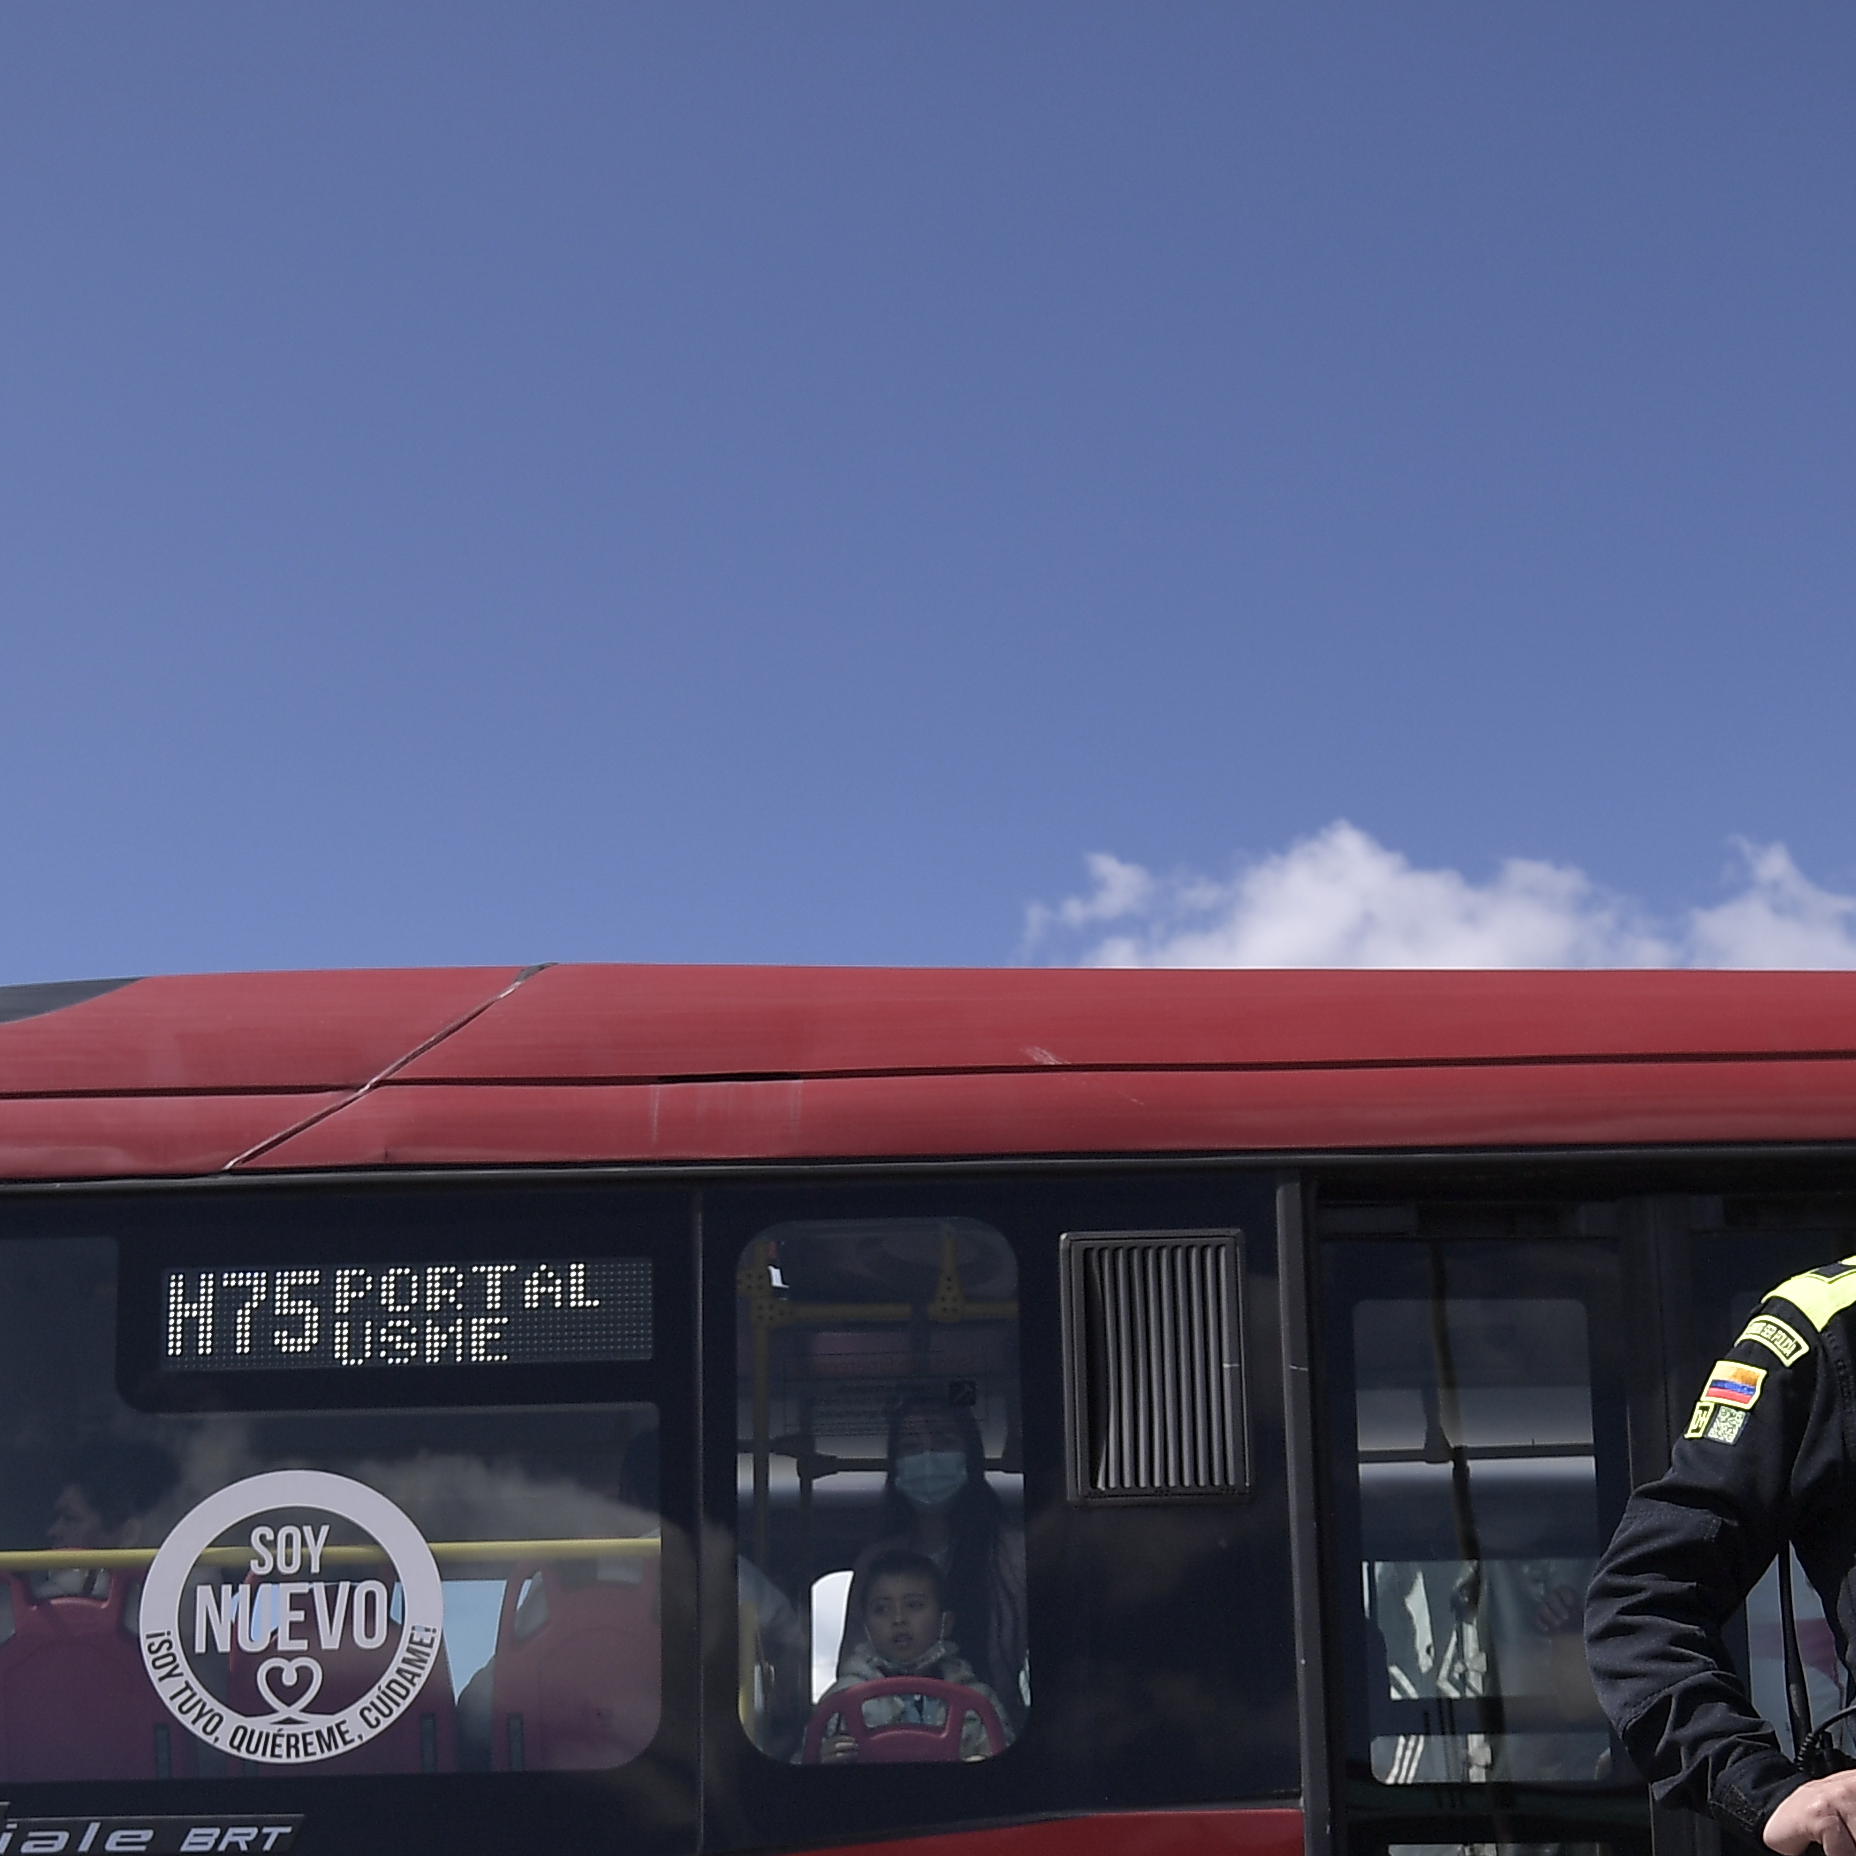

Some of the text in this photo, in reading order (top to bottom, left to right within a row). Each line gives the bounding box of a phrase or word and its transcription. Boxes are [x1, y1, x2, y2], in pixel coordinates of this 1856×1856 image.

[166, 1263, 600, 1357] H75 PORTAL
[334, 1316, 510, 1366] USME
[249, 1524, 330, 1576] SOY
[194, 1579, 389, 1654] NUEVO
[145, 1624, 438, 1760] ¡SOY TUYO, QUIÉREME, CUÍDAME!
[179, 1825, 294, 1854] BRT
